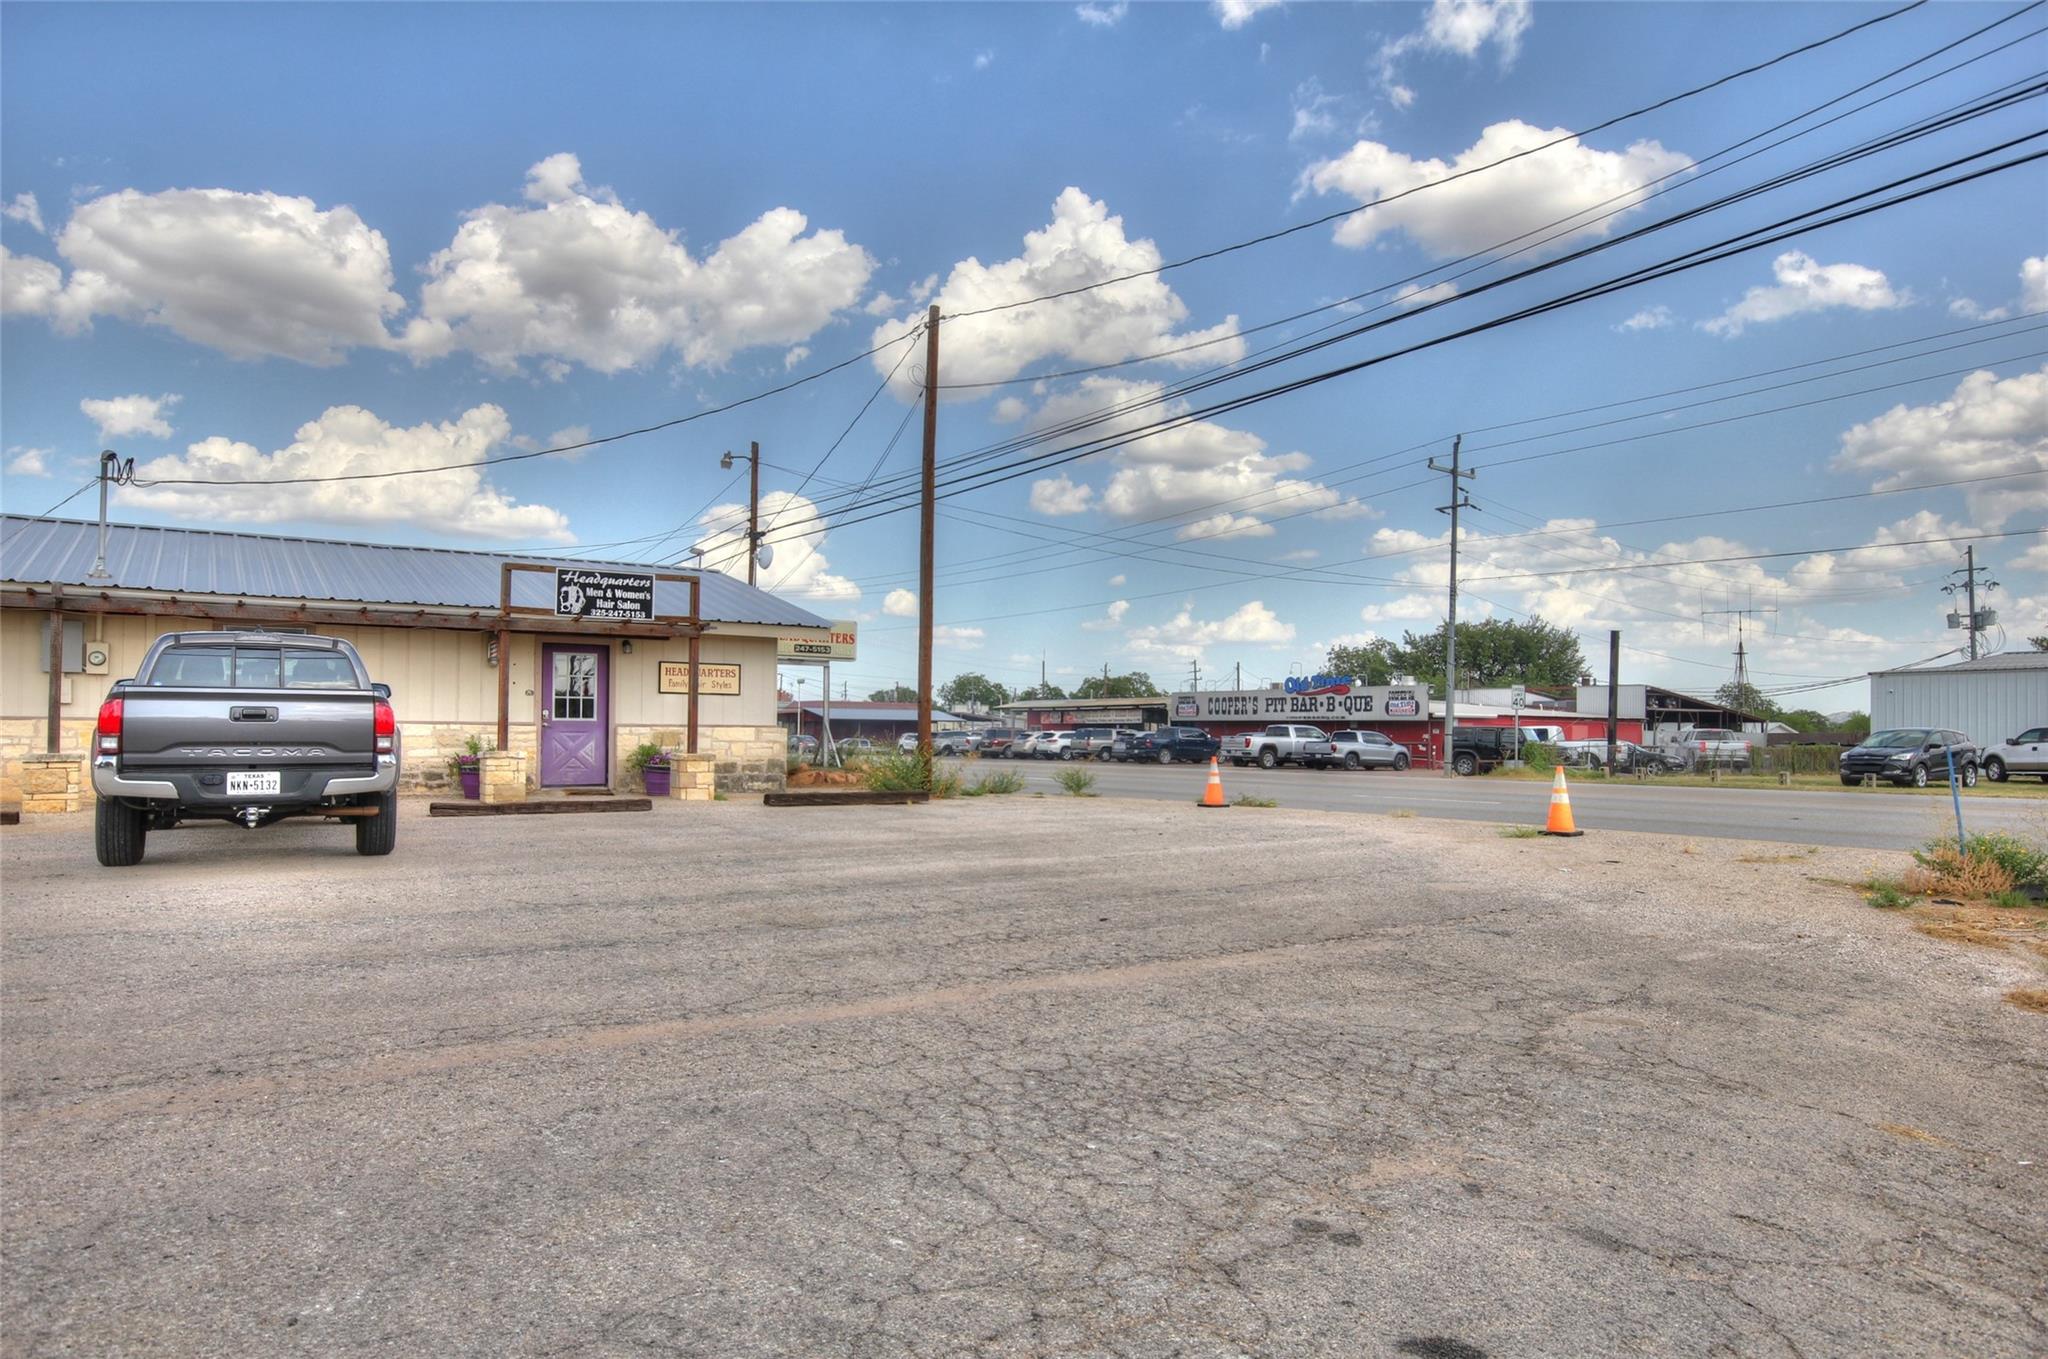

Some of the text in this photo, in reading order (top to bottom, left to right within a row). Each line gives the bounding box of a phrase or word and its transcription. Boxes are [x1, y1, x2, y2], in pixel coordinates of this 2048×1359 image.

[561, 570, 651, 588] Headquarters
[585, 587, 651, 600] Men & Women's
[596, 598, 641, 610] Hair Salon
[590, 609, 646, 618] 325-247-5153
[664, 667, 736, 678] HEADARTERS
[711, 680, 732, 689] Styles
[1284, 676, 1309, 694] Old
[1208, 696, 1258, 715] COOPER'S
[1265, 697, 1287, 712] PIT
[1513, 698, 1524, 707] 40
[180, 748, 326, 757] TACOMA
